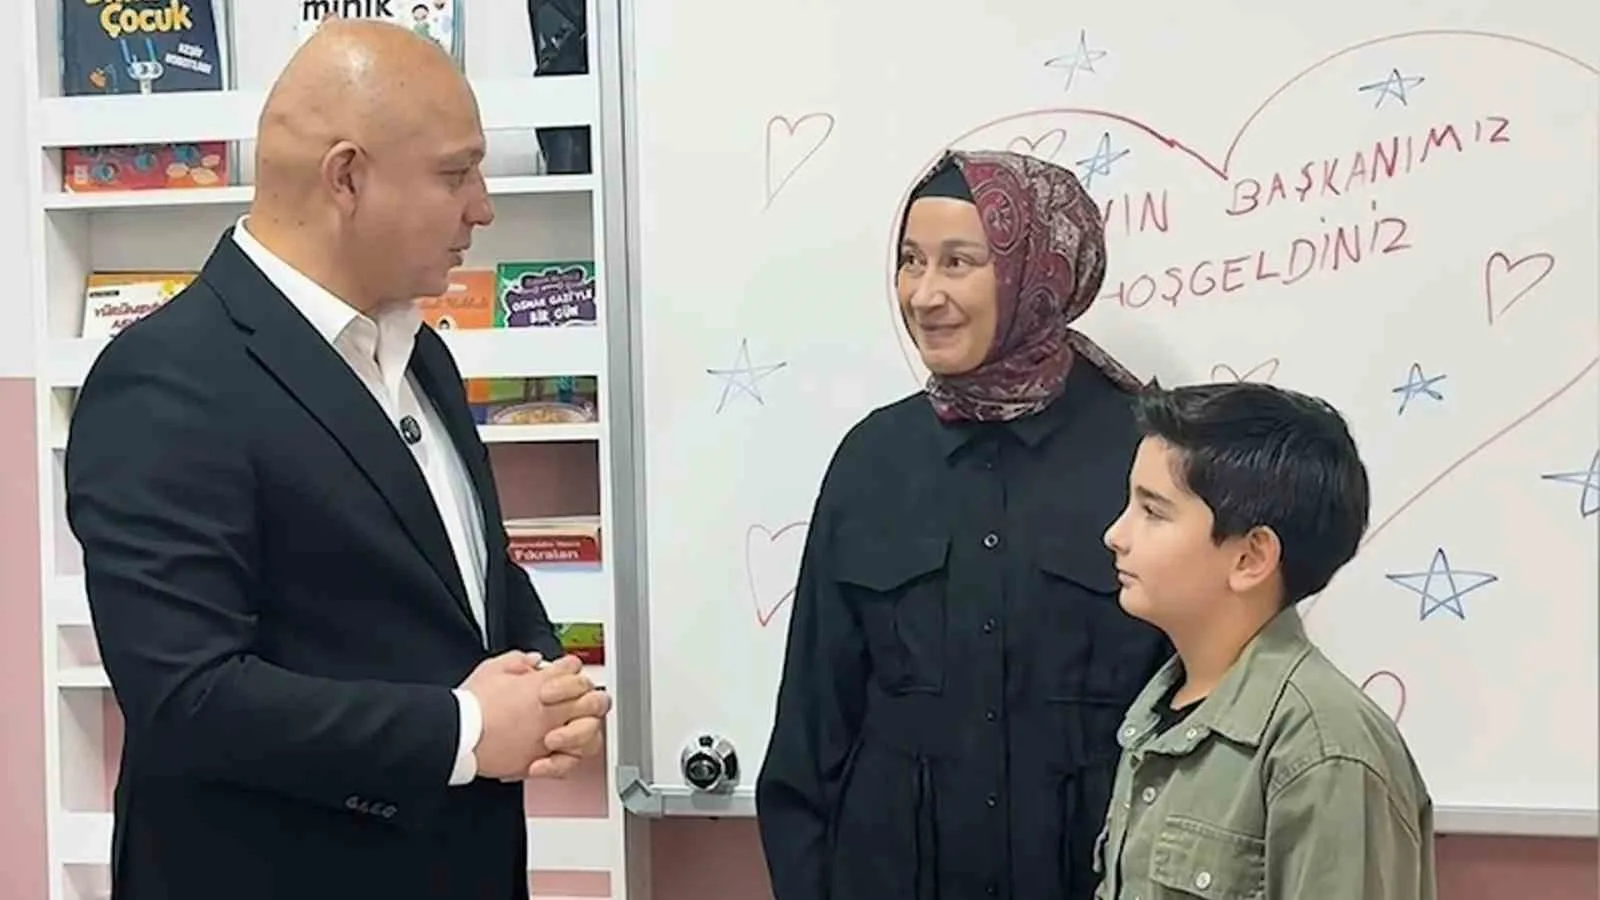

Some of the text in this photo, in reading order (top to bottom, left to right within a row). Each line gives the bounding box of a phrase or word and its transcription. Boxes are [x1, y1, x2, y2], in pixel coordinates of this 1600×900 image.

[100, 0, 193, 38] Çocuk
[1226, 117, 1510, 216] BAŞKANIMIZ
[1100, 200, 1412, 308] HOŞGELDİNİZ
